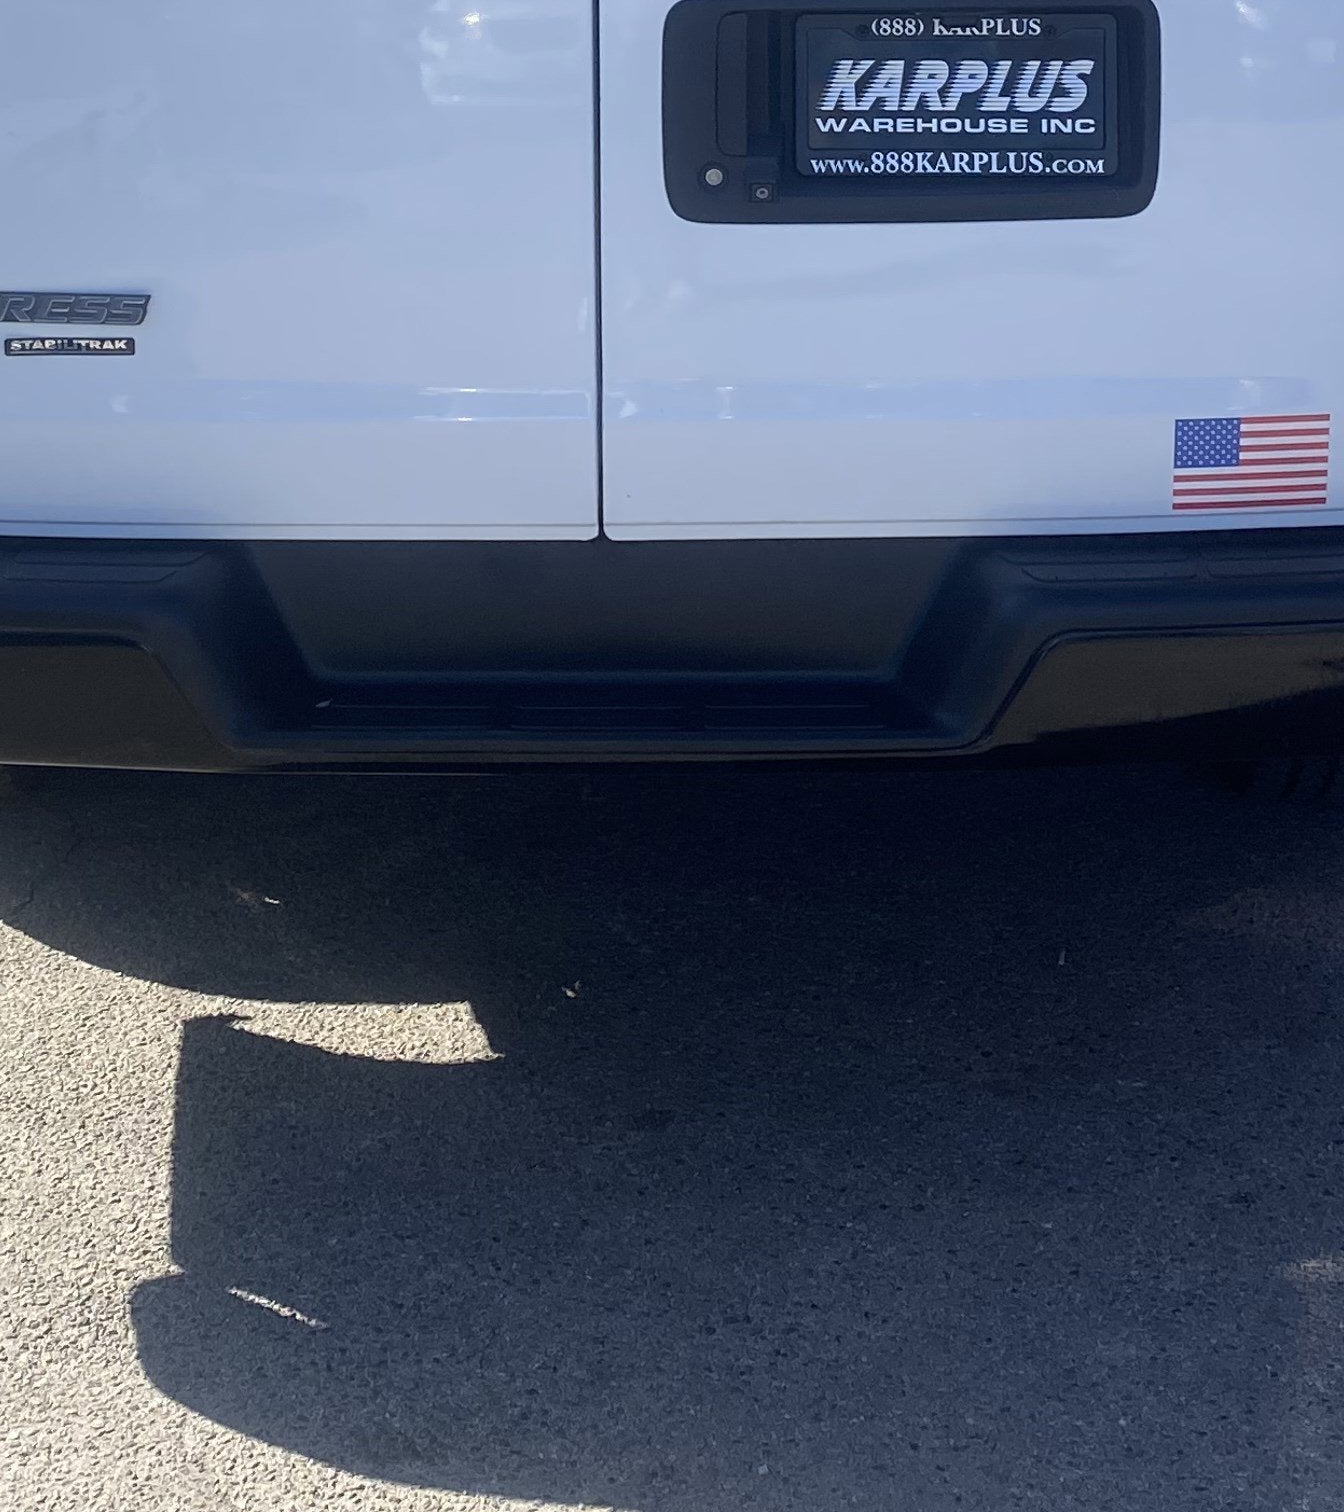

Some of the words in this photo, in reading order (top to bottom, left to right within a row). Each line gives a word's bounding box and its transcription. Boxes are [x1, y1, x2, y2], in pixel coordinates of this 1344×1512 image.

[871, 18, 924, 36] (888)
[816, 59, 1094, 113] KARPLUS
[816, 117, 1028, 134] WAREHOUSE
[1041, 118, 1096, 134] INC
